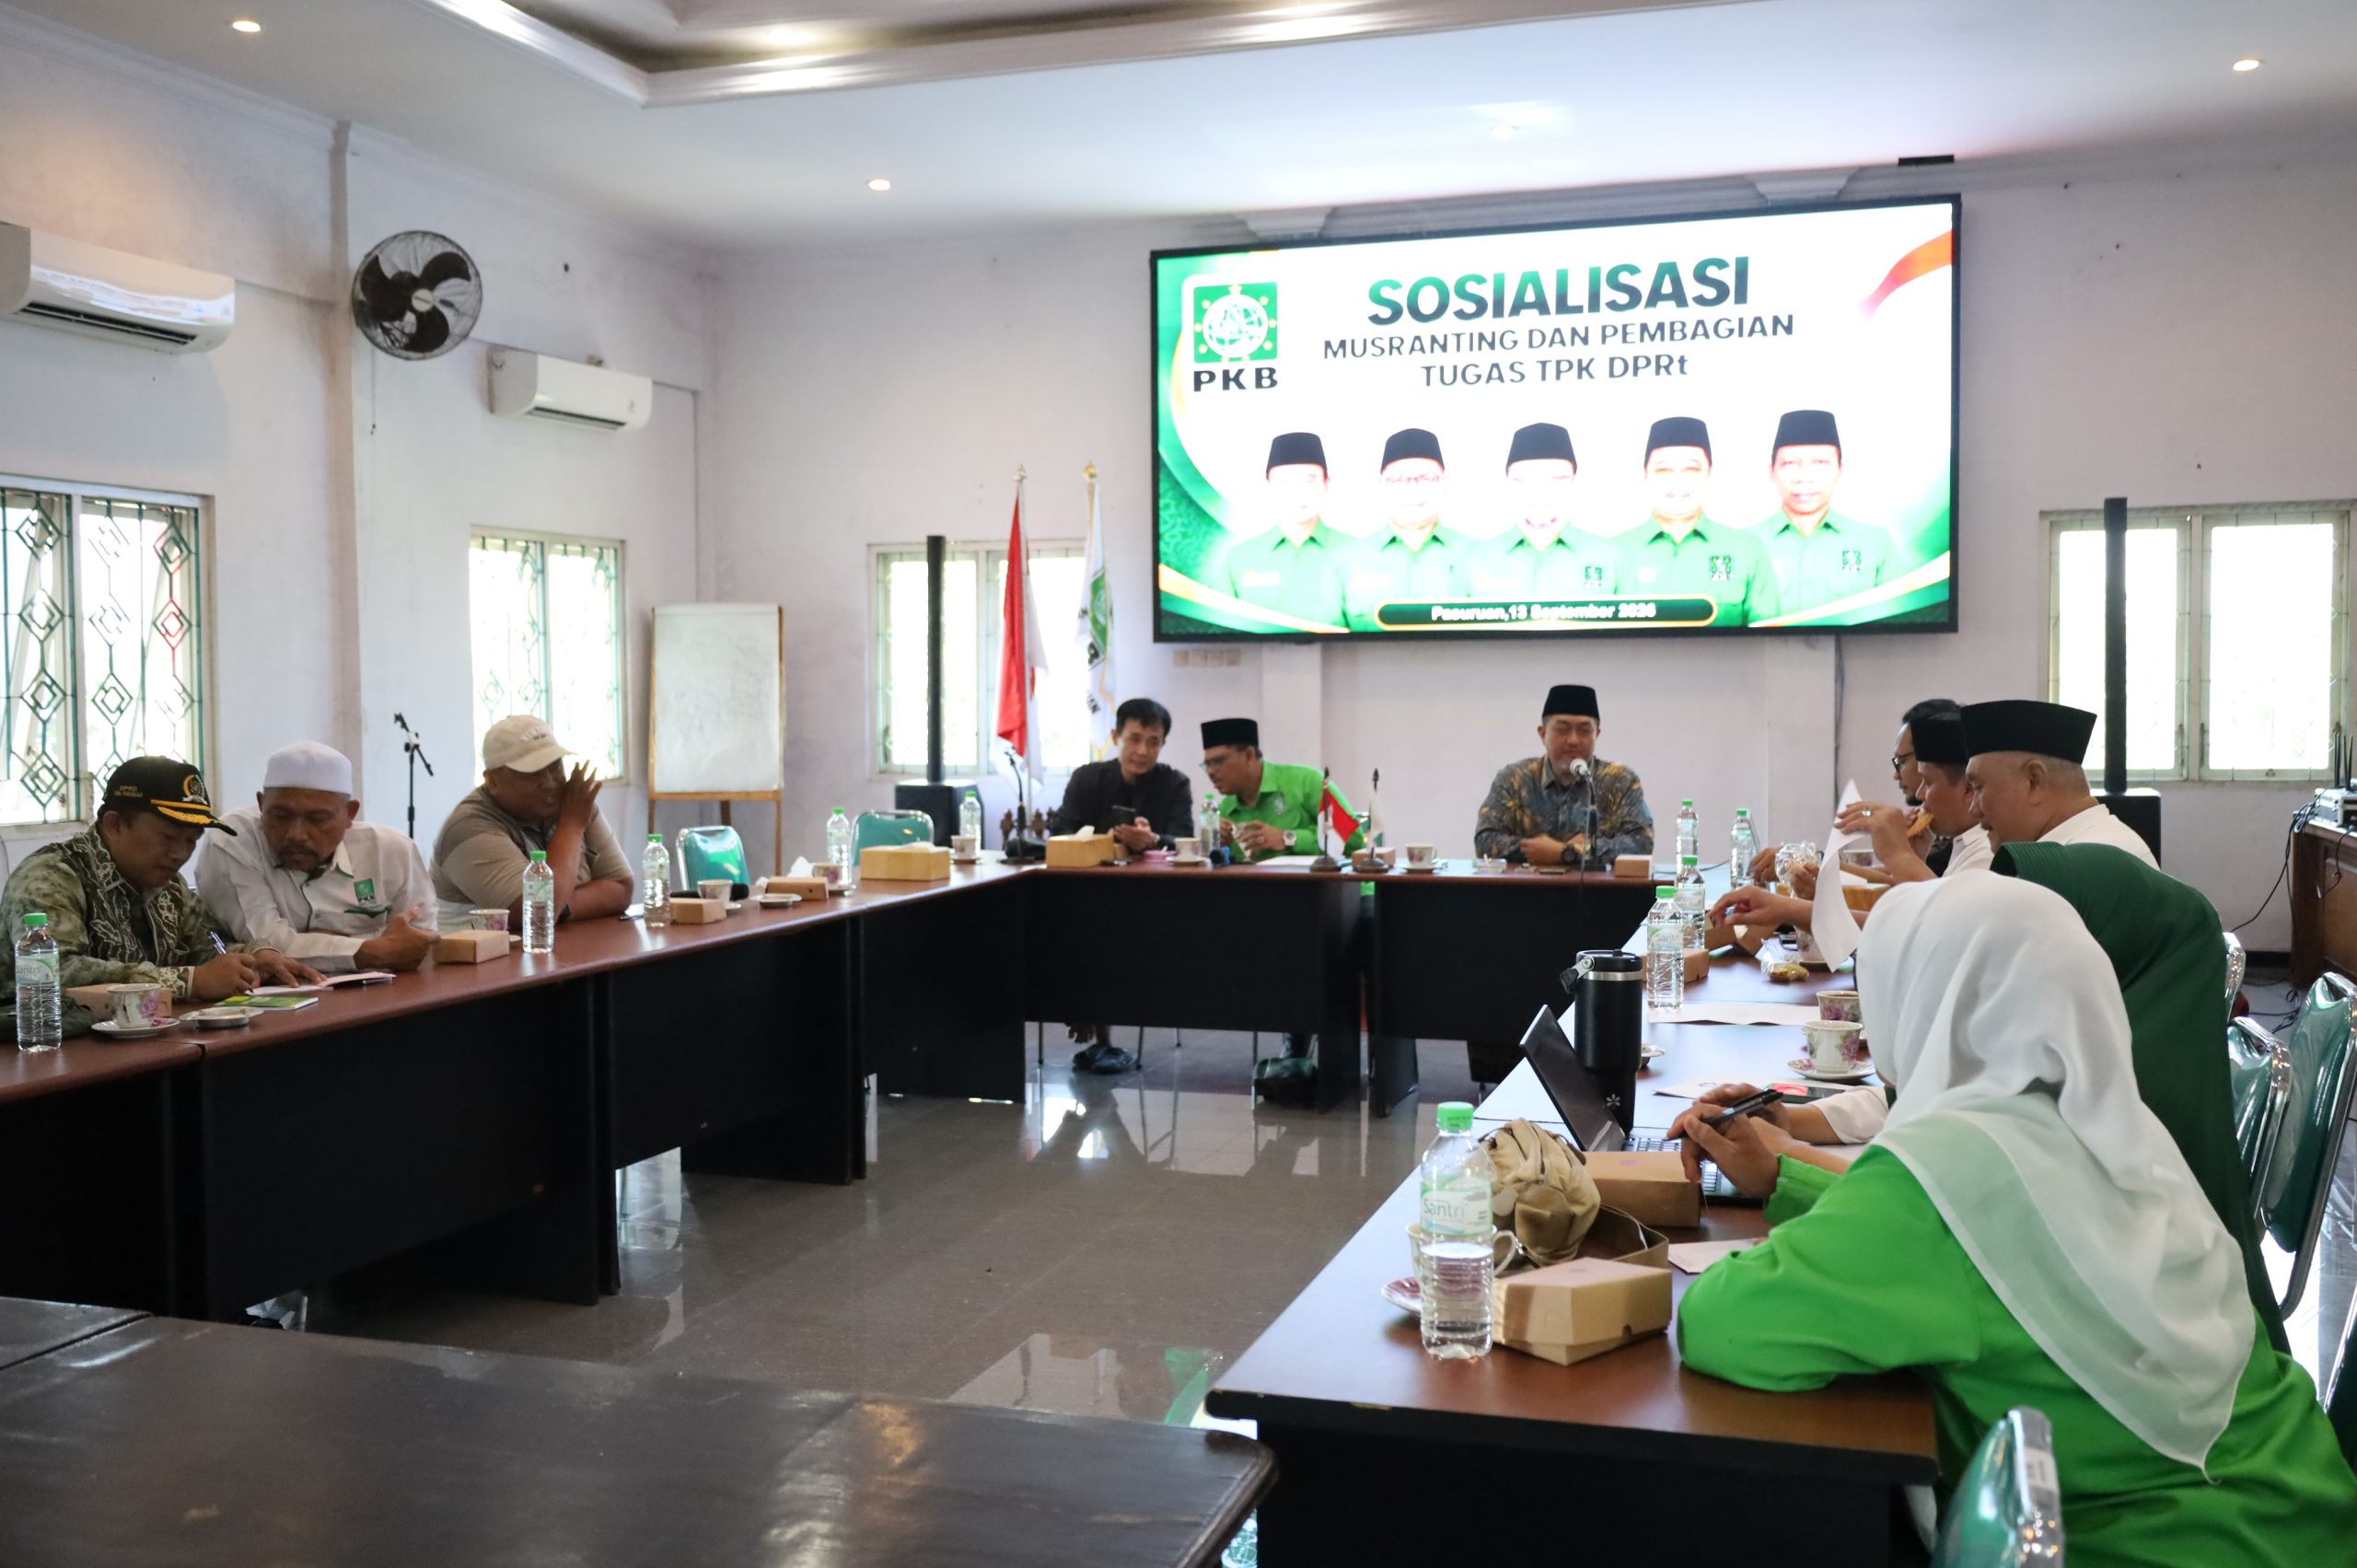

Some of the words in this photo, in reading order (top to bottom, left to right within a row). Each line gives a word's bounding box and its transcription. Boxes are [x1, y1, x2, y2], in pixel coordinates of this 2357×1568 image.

[1367, 256, 1749, 326] SOSIALISASI
[1324, 330, 1519, 359] MUSRANTING
[1528, 326, 1589, 349] DAN
[1600, 314, 1794, 345] PEMBAGIAN
[1193, 367, 1278, 392] PKB
[1421, 361, 1526, 387] TUGAS
[1536, 357, 1596, 381] TPK
[1608, 354, 1689, 378] DPRt
[1529, 603, 1616, 620] September
[1423, 1198, 1468, 1218] Santri
